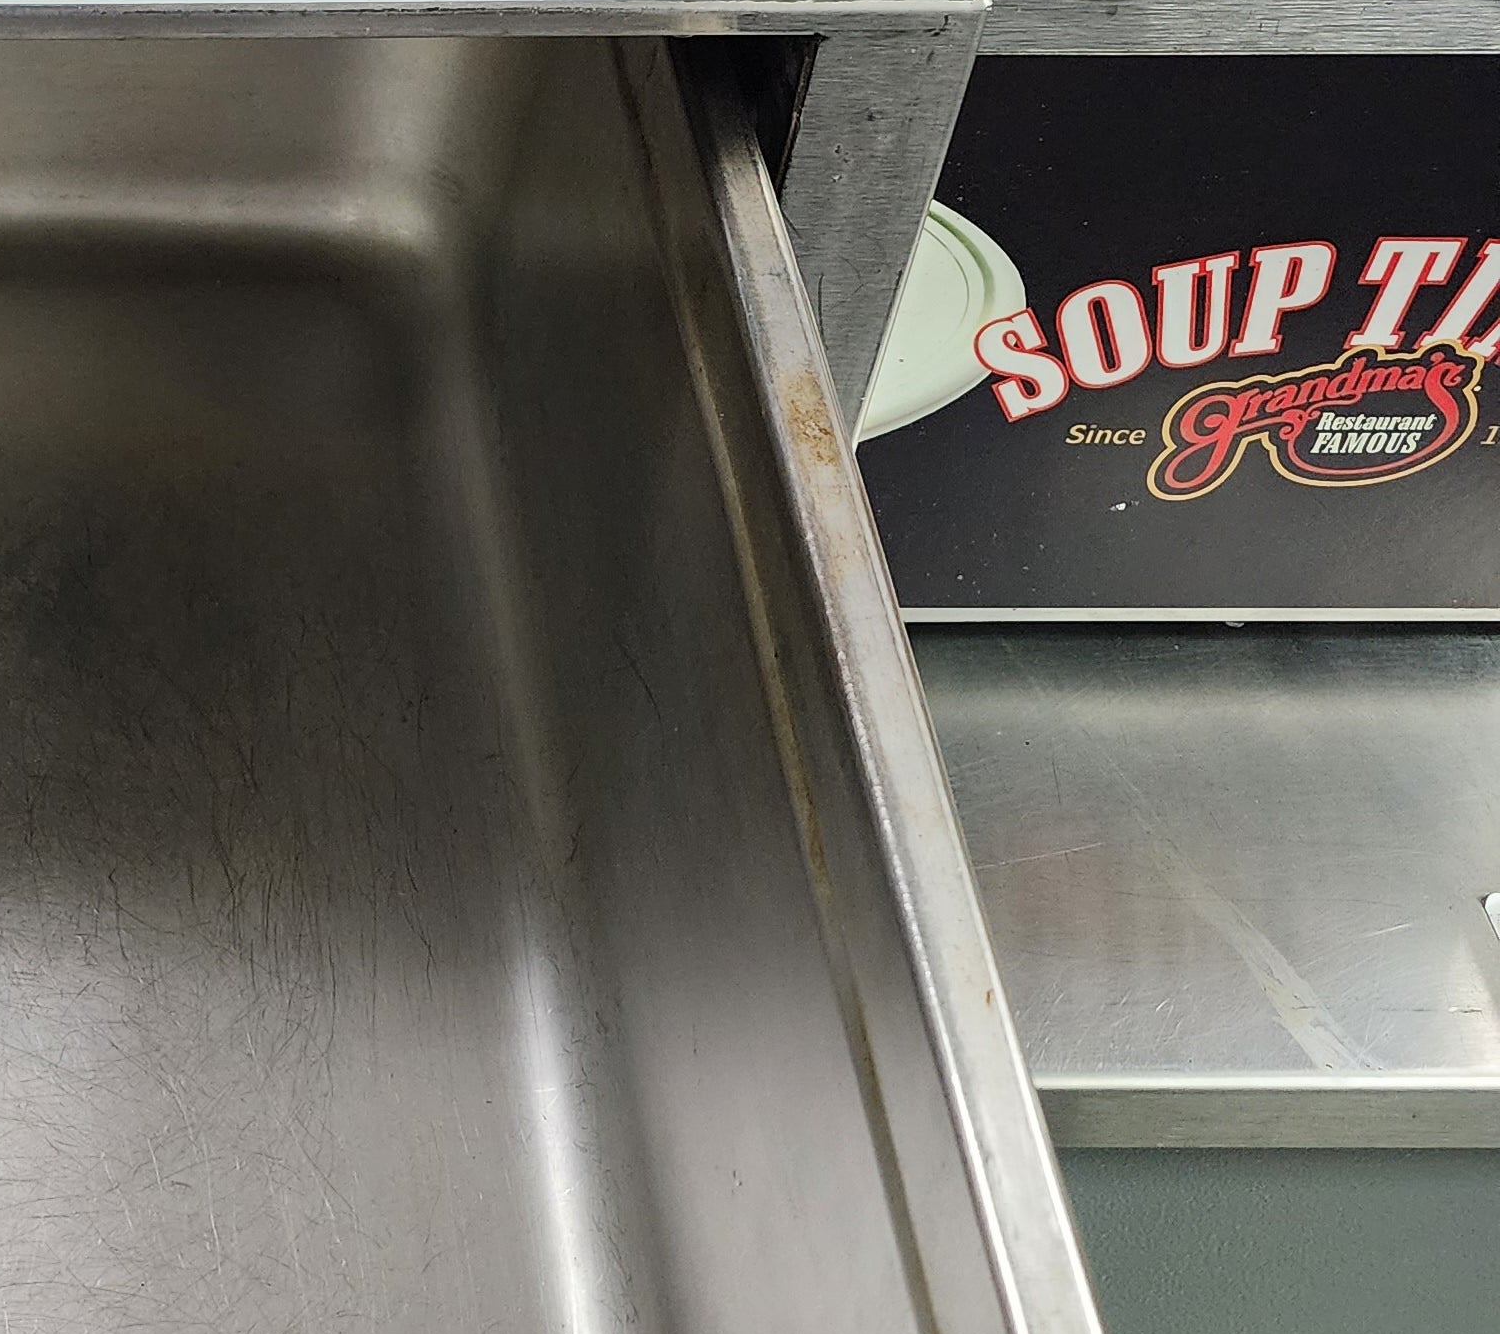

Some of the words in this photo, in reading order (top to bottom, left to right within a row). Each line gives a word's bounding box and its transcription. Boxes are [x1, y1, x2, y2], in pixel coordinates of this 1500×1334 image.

[973, 240, 1337, 423] SOUP
[1316, 412, 1438, 431] Restaurant
[1065, 423, 1147, 446] Since
[1310, 432, 1422, 454] FAMOUS
